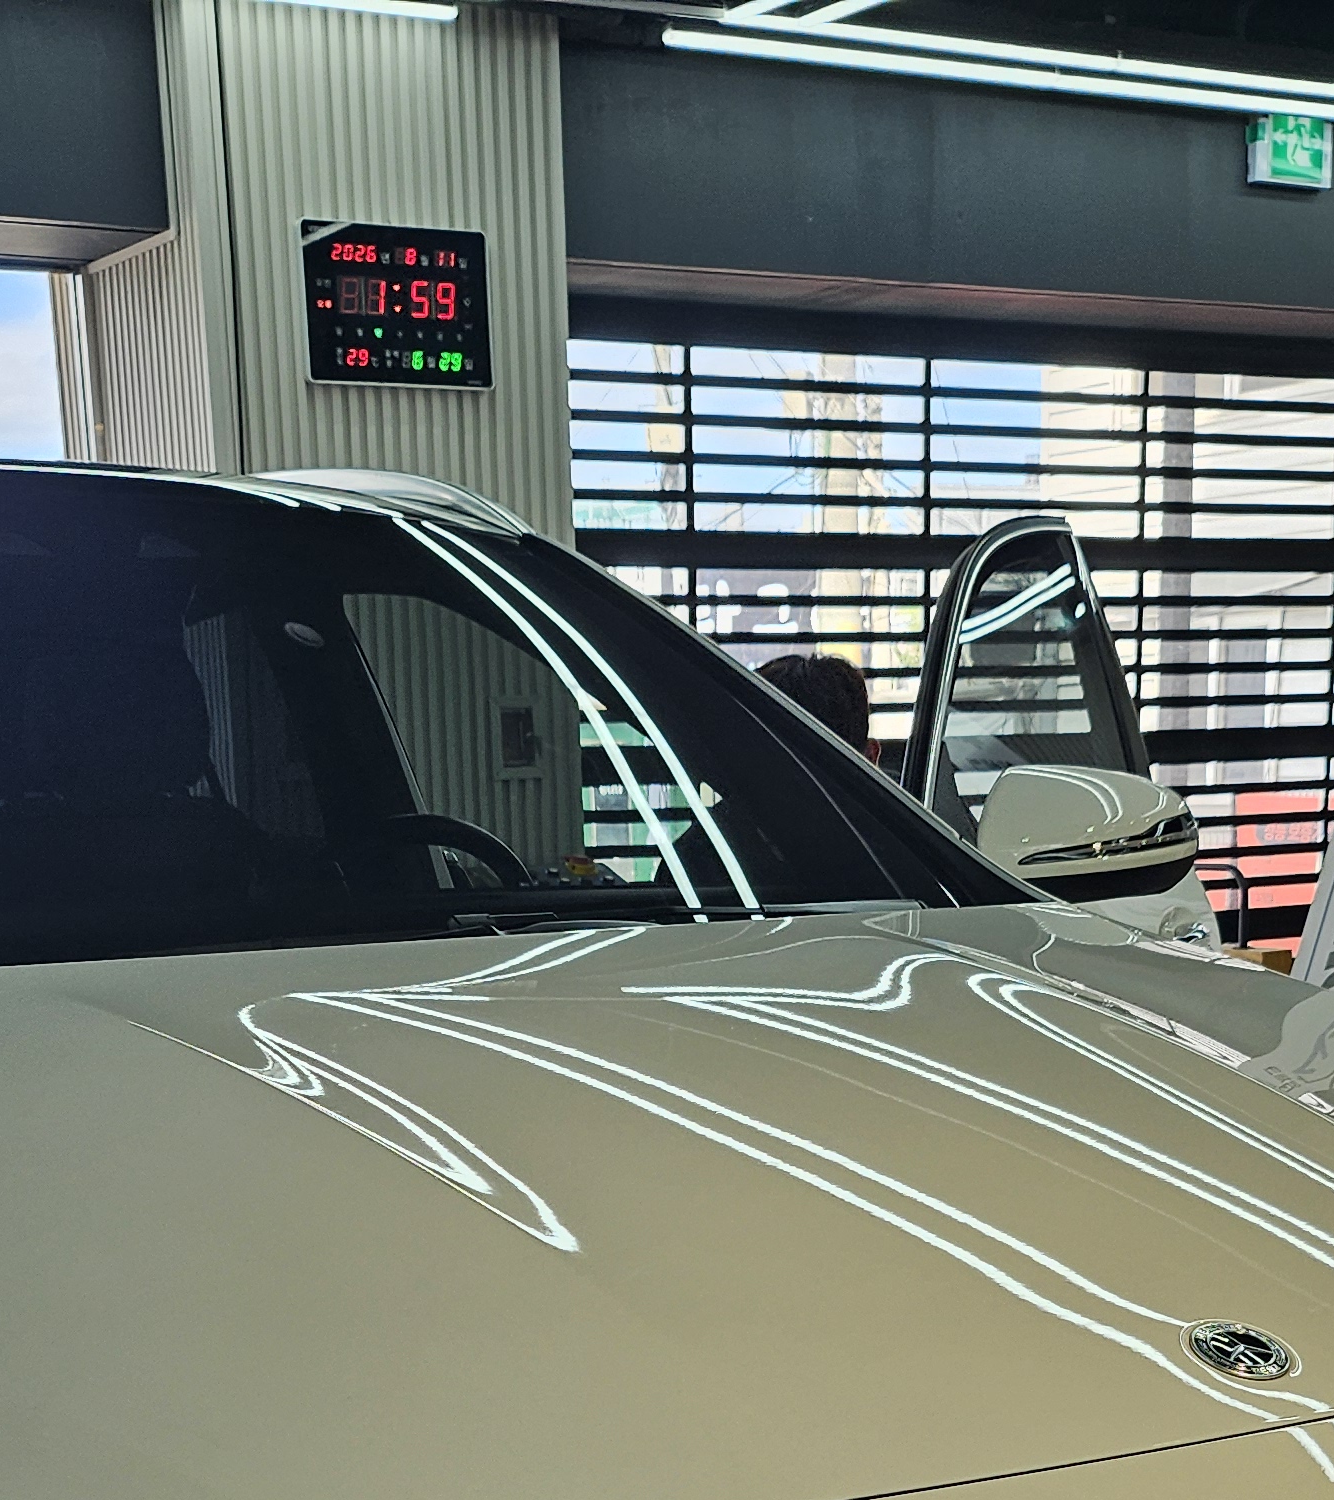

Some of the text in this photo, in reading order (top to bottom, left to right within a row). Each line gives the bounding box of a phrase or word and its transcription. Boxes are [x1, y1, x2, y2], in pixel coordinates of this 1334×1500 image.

[331, 243, 377, 263] 2026
[404, 247, 417, 266] 8
[437, 251, 456, 268] 11
[378, 279, 456, 321] 1:59
[346, 348, 369, 367] 29
[411, 350, 424, 371] 6
